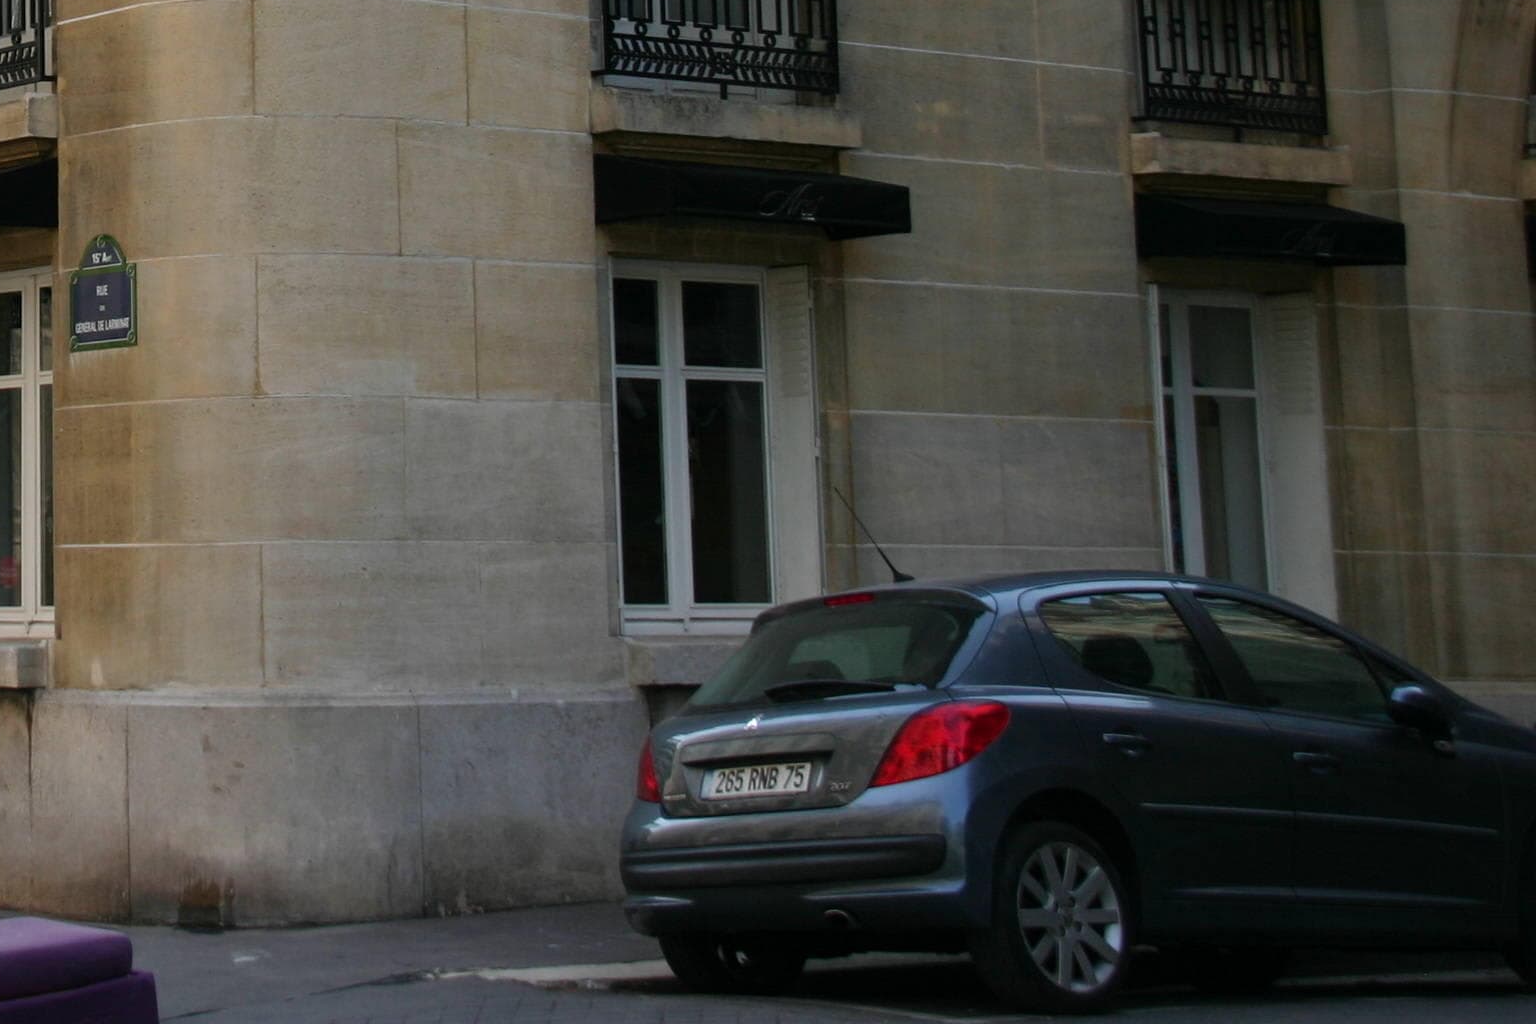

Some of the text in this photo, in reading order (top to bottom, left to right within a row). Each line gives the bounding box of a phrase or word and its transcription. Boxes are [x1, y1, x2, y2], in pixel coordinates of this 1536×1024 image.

[96, 284, 109, 296] RUE
[715, 764, 806, 794] 265 RNB 75
